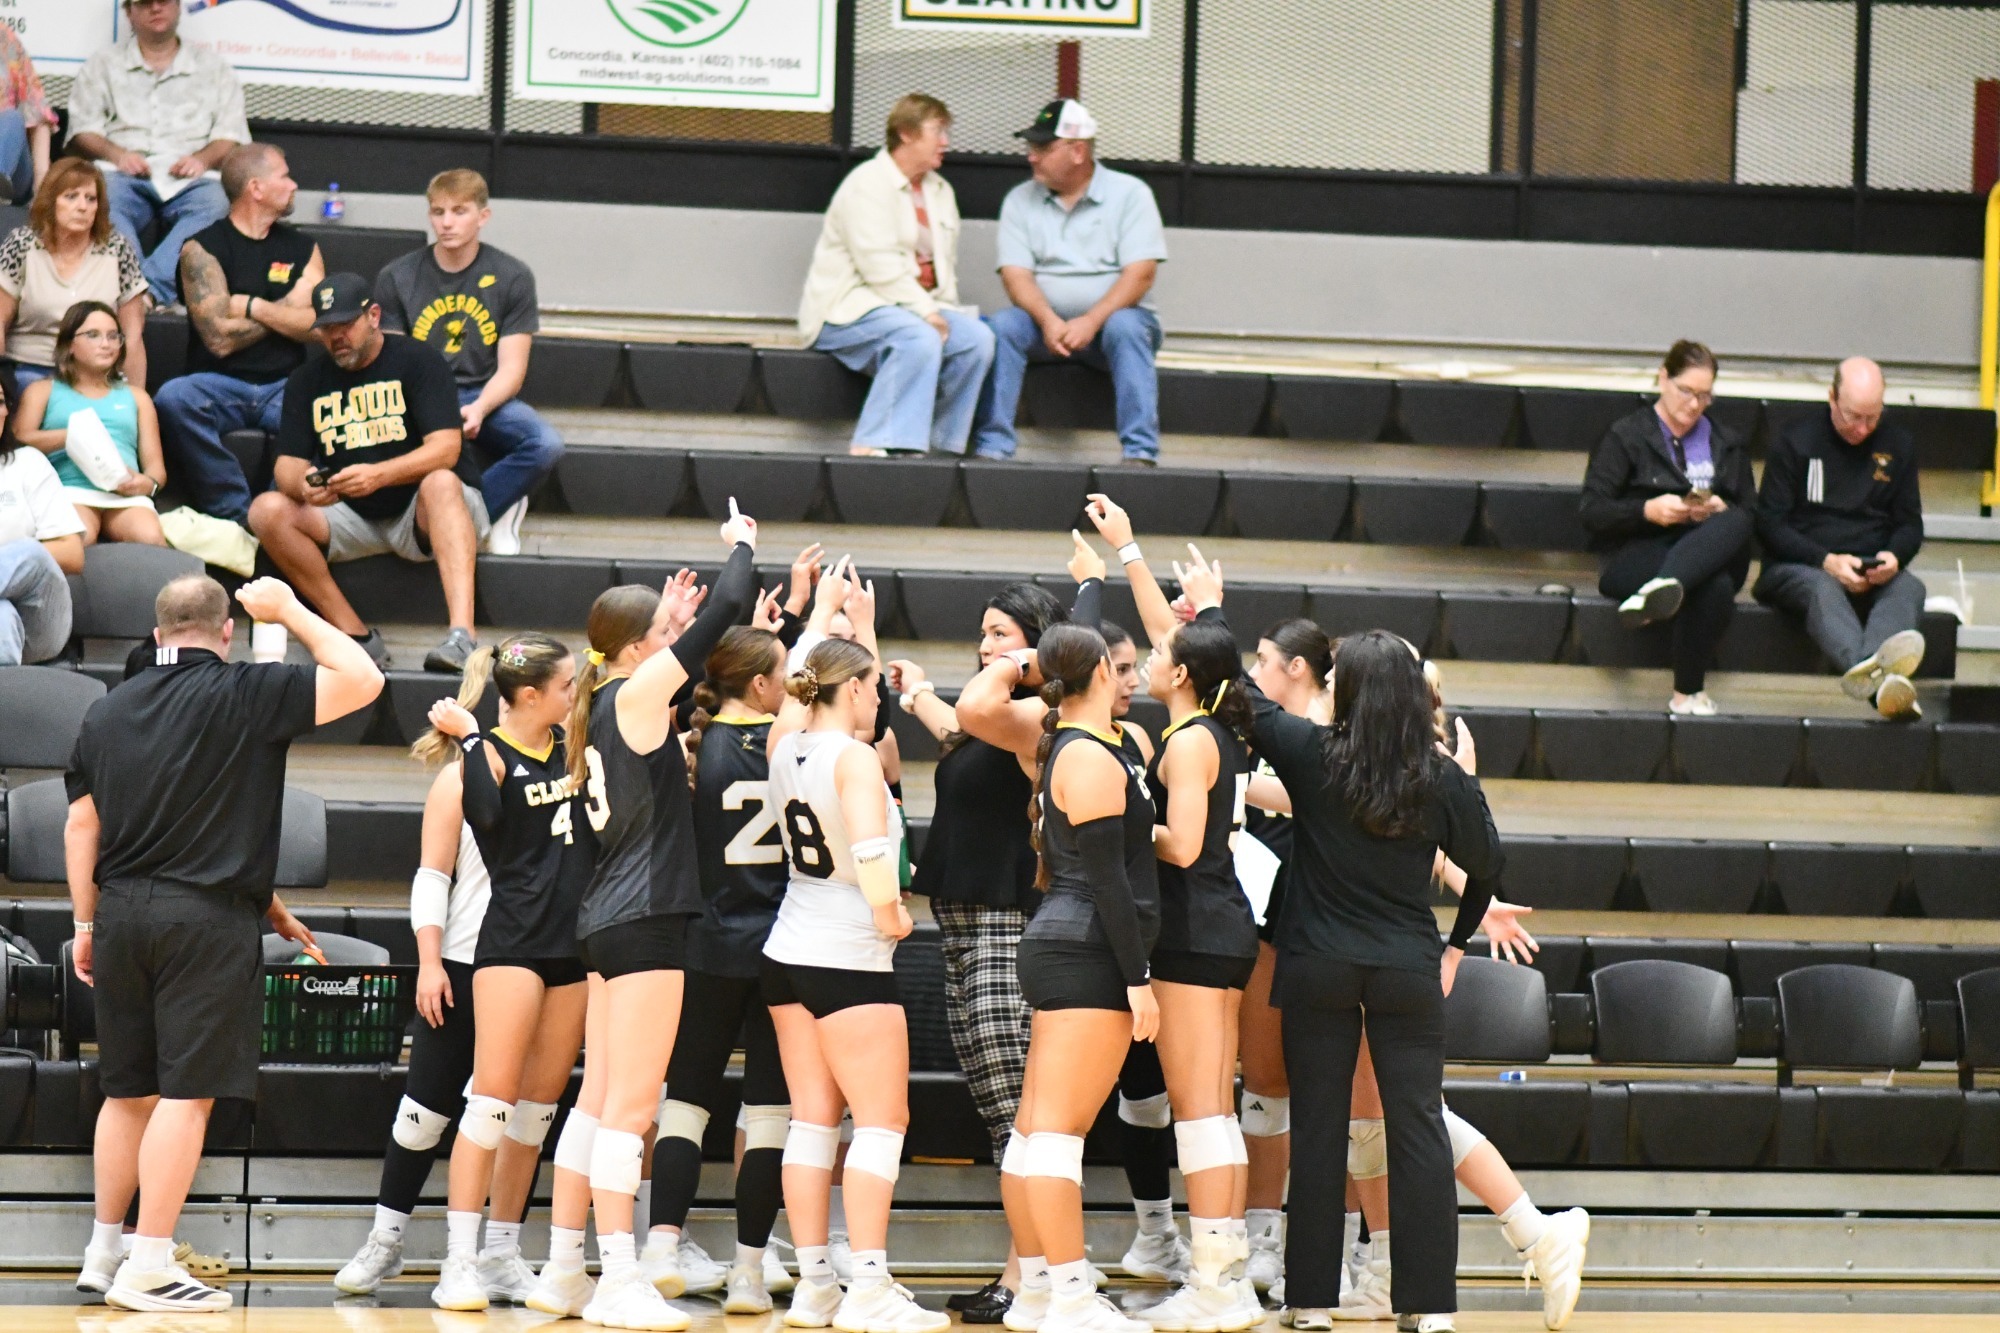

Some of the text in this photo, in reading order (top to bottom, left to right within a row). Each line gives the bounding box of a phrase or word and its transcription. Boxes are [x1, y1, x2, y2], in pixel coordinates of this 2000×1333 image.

[267, 43, 337, 59] Concordia
[351, 47, 411, 62] Belleville
[548, 47, 625, 63] Concordia,
[631, 51, 685, 65] Kansas
[579, 67, 770, 86] midwest-ag-solutions.com
[412, 293, 498, 346] HUNDERBIRDS
[313, 379, 407, 433] CLOUD
[320, 415, 408, 456] T-BIRDS
[550, 801, 574, 845] 4
[722, 780, 784, 865] 2
[784, 798, 835, 880] 8
